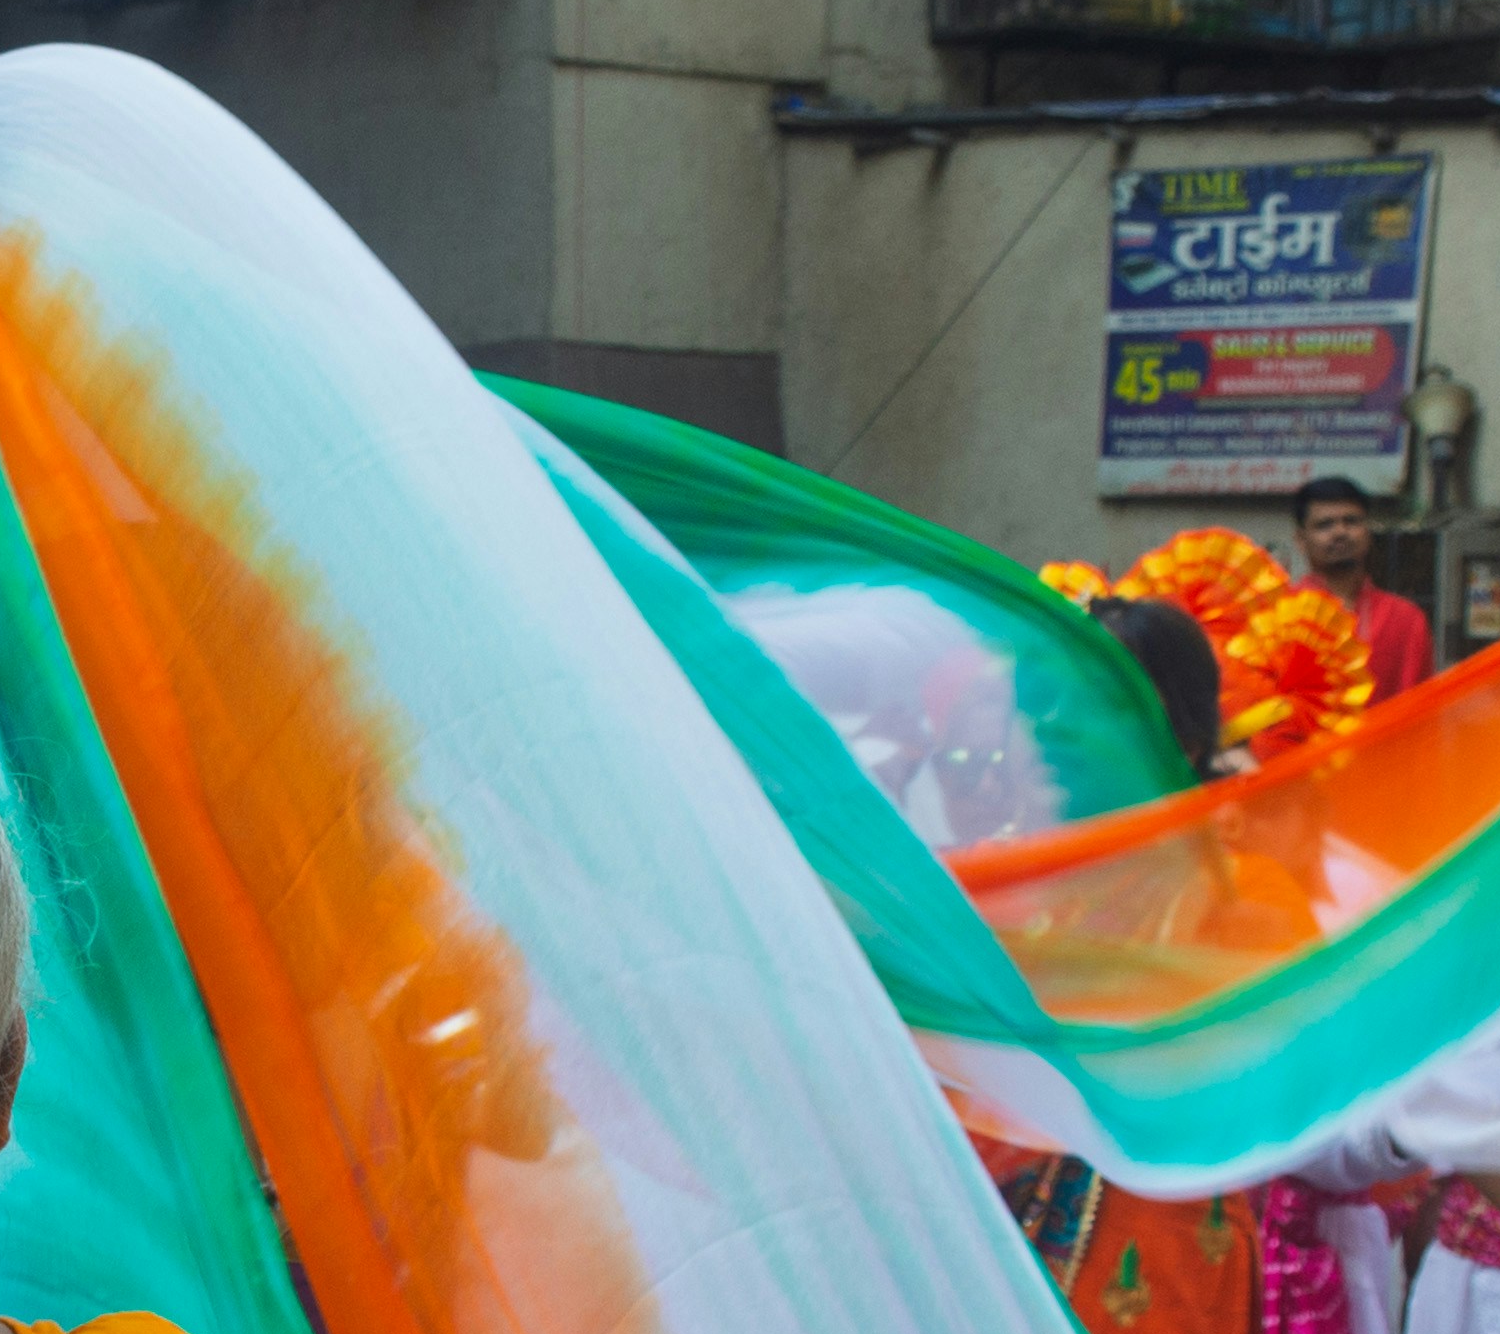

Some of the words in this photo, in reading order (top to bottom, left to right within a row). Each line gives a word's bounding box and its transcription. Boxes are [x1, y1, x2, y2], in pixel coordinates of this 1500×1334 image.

[1162, 172, 1241, 203] TIME
[1172, 193, 1340, 270] टाईम
[1113, 359, 1162, 403] 45
